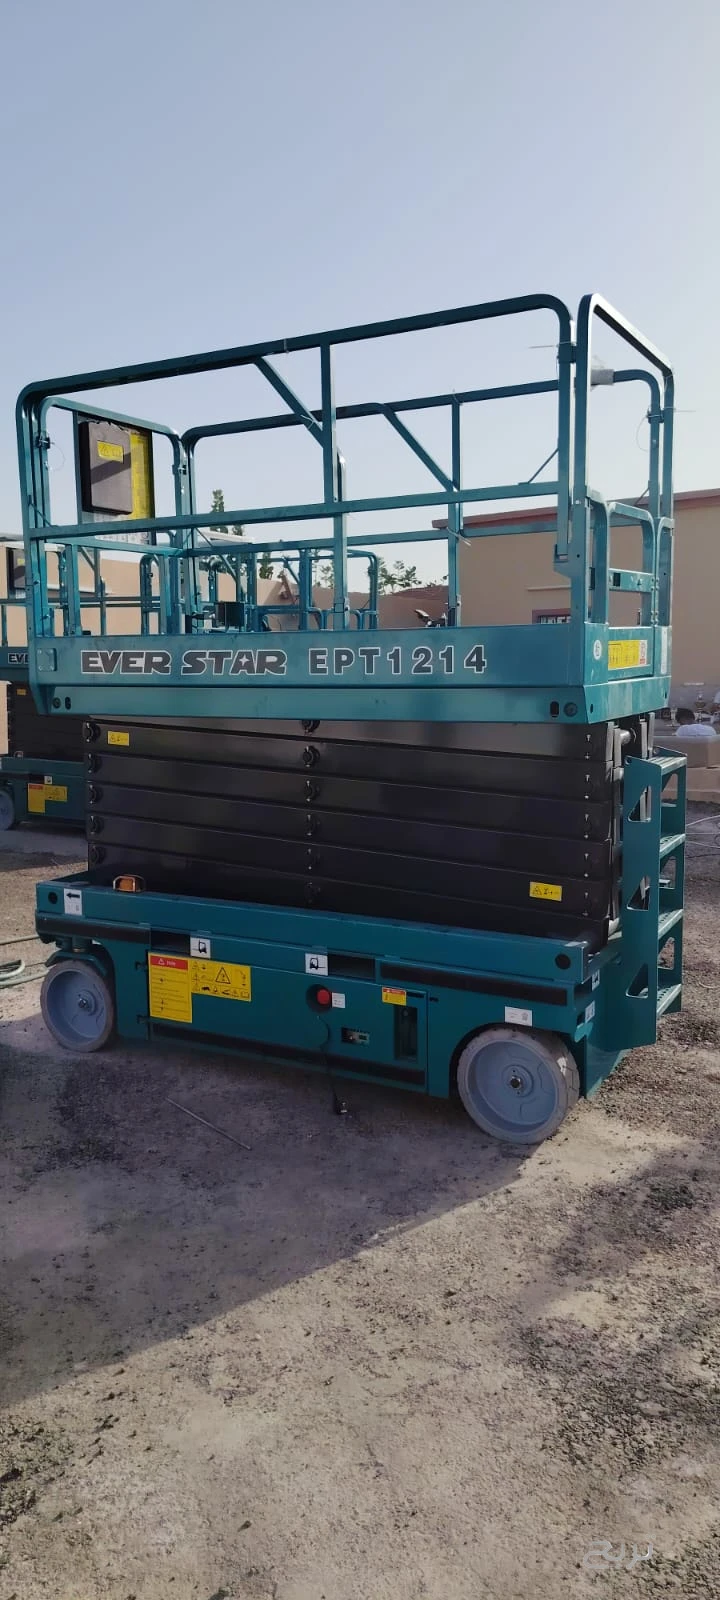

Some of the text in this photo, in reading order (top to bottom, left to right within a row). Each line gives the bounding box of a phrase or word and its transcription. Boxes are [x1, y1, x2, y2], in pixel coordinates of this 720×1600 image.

[80, 645, 487, 676] EVER STAR EPT1214
